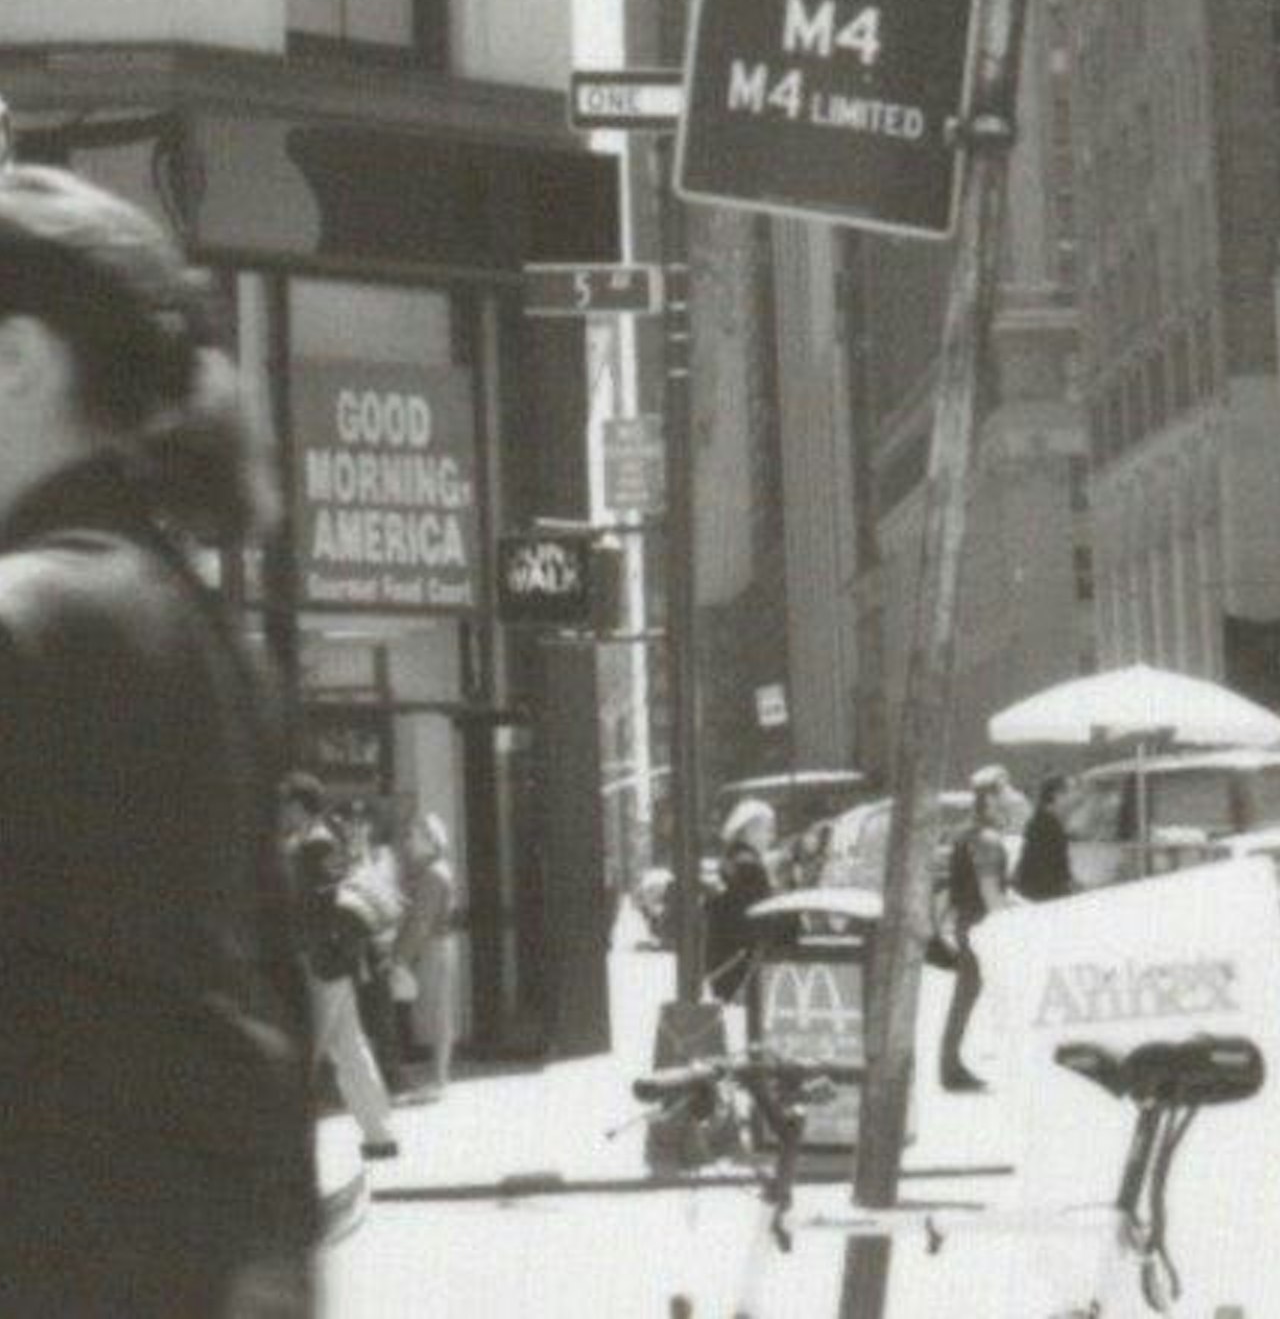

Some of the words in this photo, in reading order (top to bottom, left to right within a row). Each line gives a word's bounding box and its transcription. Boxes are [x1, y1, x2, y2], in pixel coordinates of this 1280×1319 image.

[588, 86, 640, 114] ONE
[727, 59, 803, 119] M4
[810, 90, 925, 141] LIMITED
[335, 389, 431, 446] GOOD
[313, 508, 466, 567] AMERICA
